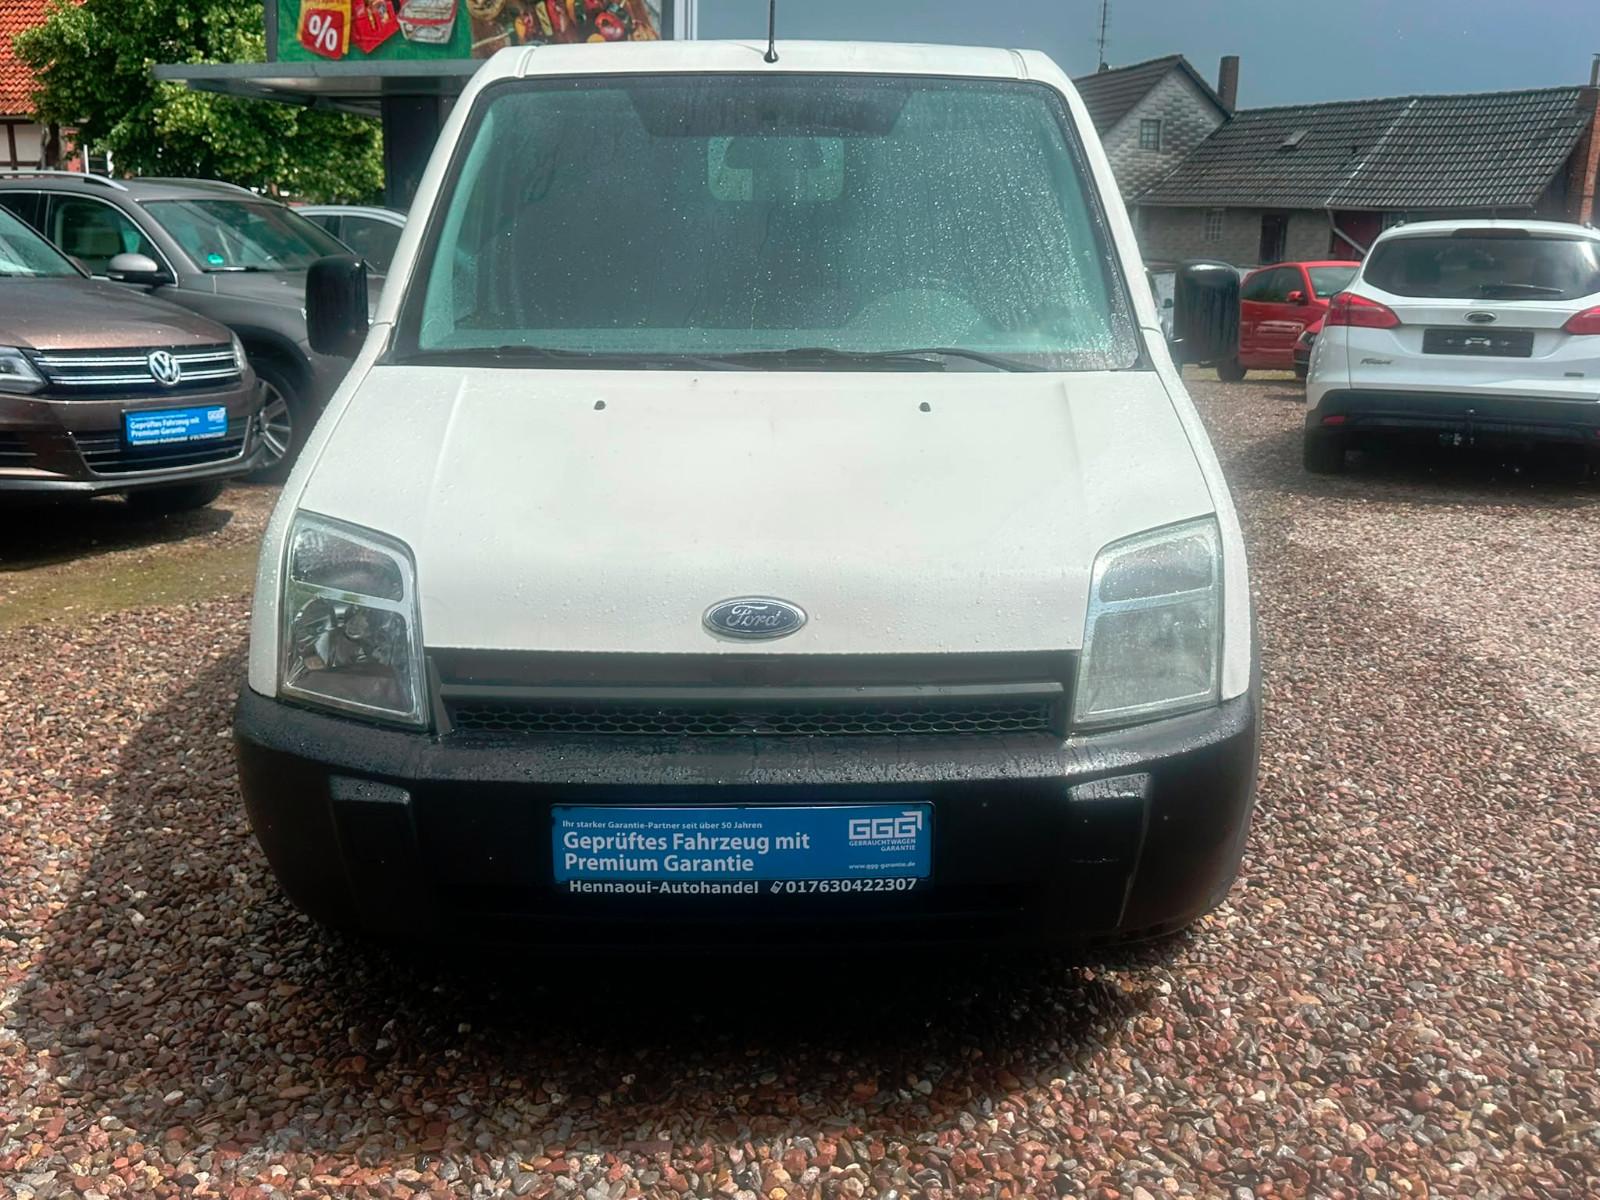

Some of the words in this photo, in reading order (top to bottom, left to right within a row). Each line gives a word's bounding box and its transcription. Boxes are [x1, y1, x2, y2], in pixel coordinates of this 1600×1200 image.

[726, 604, 781, 627] Ford
[562, 820, 575, 828] Ihr
[576, 820, 606, 829] starker
[607, 821, 680, 830] Garantie-Partner
[682, 822, 698, 830] seit
[699, 821, 719, 830] über
[733, 821, 763, 829] Jahren
[848, 817, 916, 840] GGG
[563, 831, 667, 854] Geprüftes
[672, 832, 769, 855] Fahrzeug
[775, 831, 810, 850] mit
[848, 838, 916, 846] GEBRAUCHTWAGEN
[564, 852, 658, 872] Premium
[663, 853, 754, 872] Garantie
[569, 880, 759, 894] Hennaoui-Autohandel
[785, 878, 917, 893] 017630422307
